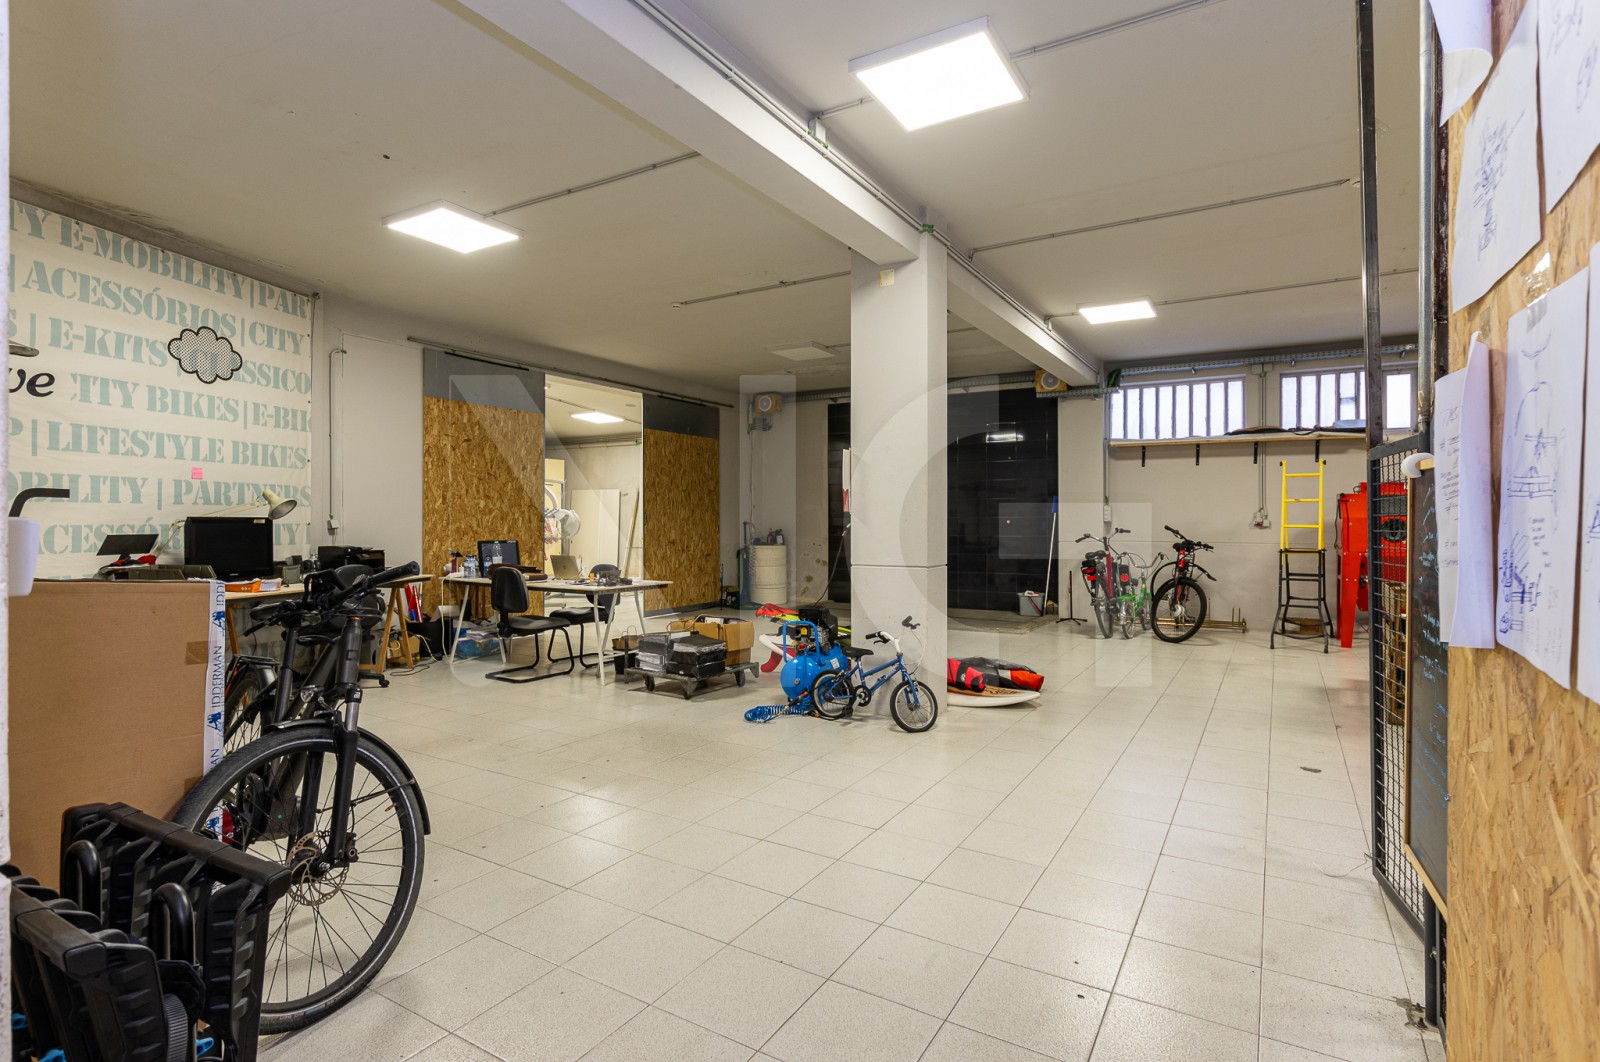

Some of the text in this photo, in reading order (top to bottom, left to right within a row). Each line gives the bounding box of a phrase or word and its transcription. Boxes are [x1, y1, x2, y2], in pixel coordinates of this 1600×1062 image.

[59, 216, 247, 300] E-MOBILITY
[22, 260, 237, 339] ACESSÓRIOS
[249, 321, 304, 355] CITY
[48, 317, 168, 367] E-KITS
[146, 384, 240, 424] BIKES
[46, 420, 225, 464] LIFESTYLE
[231, 440, 308, 470] BIKES
